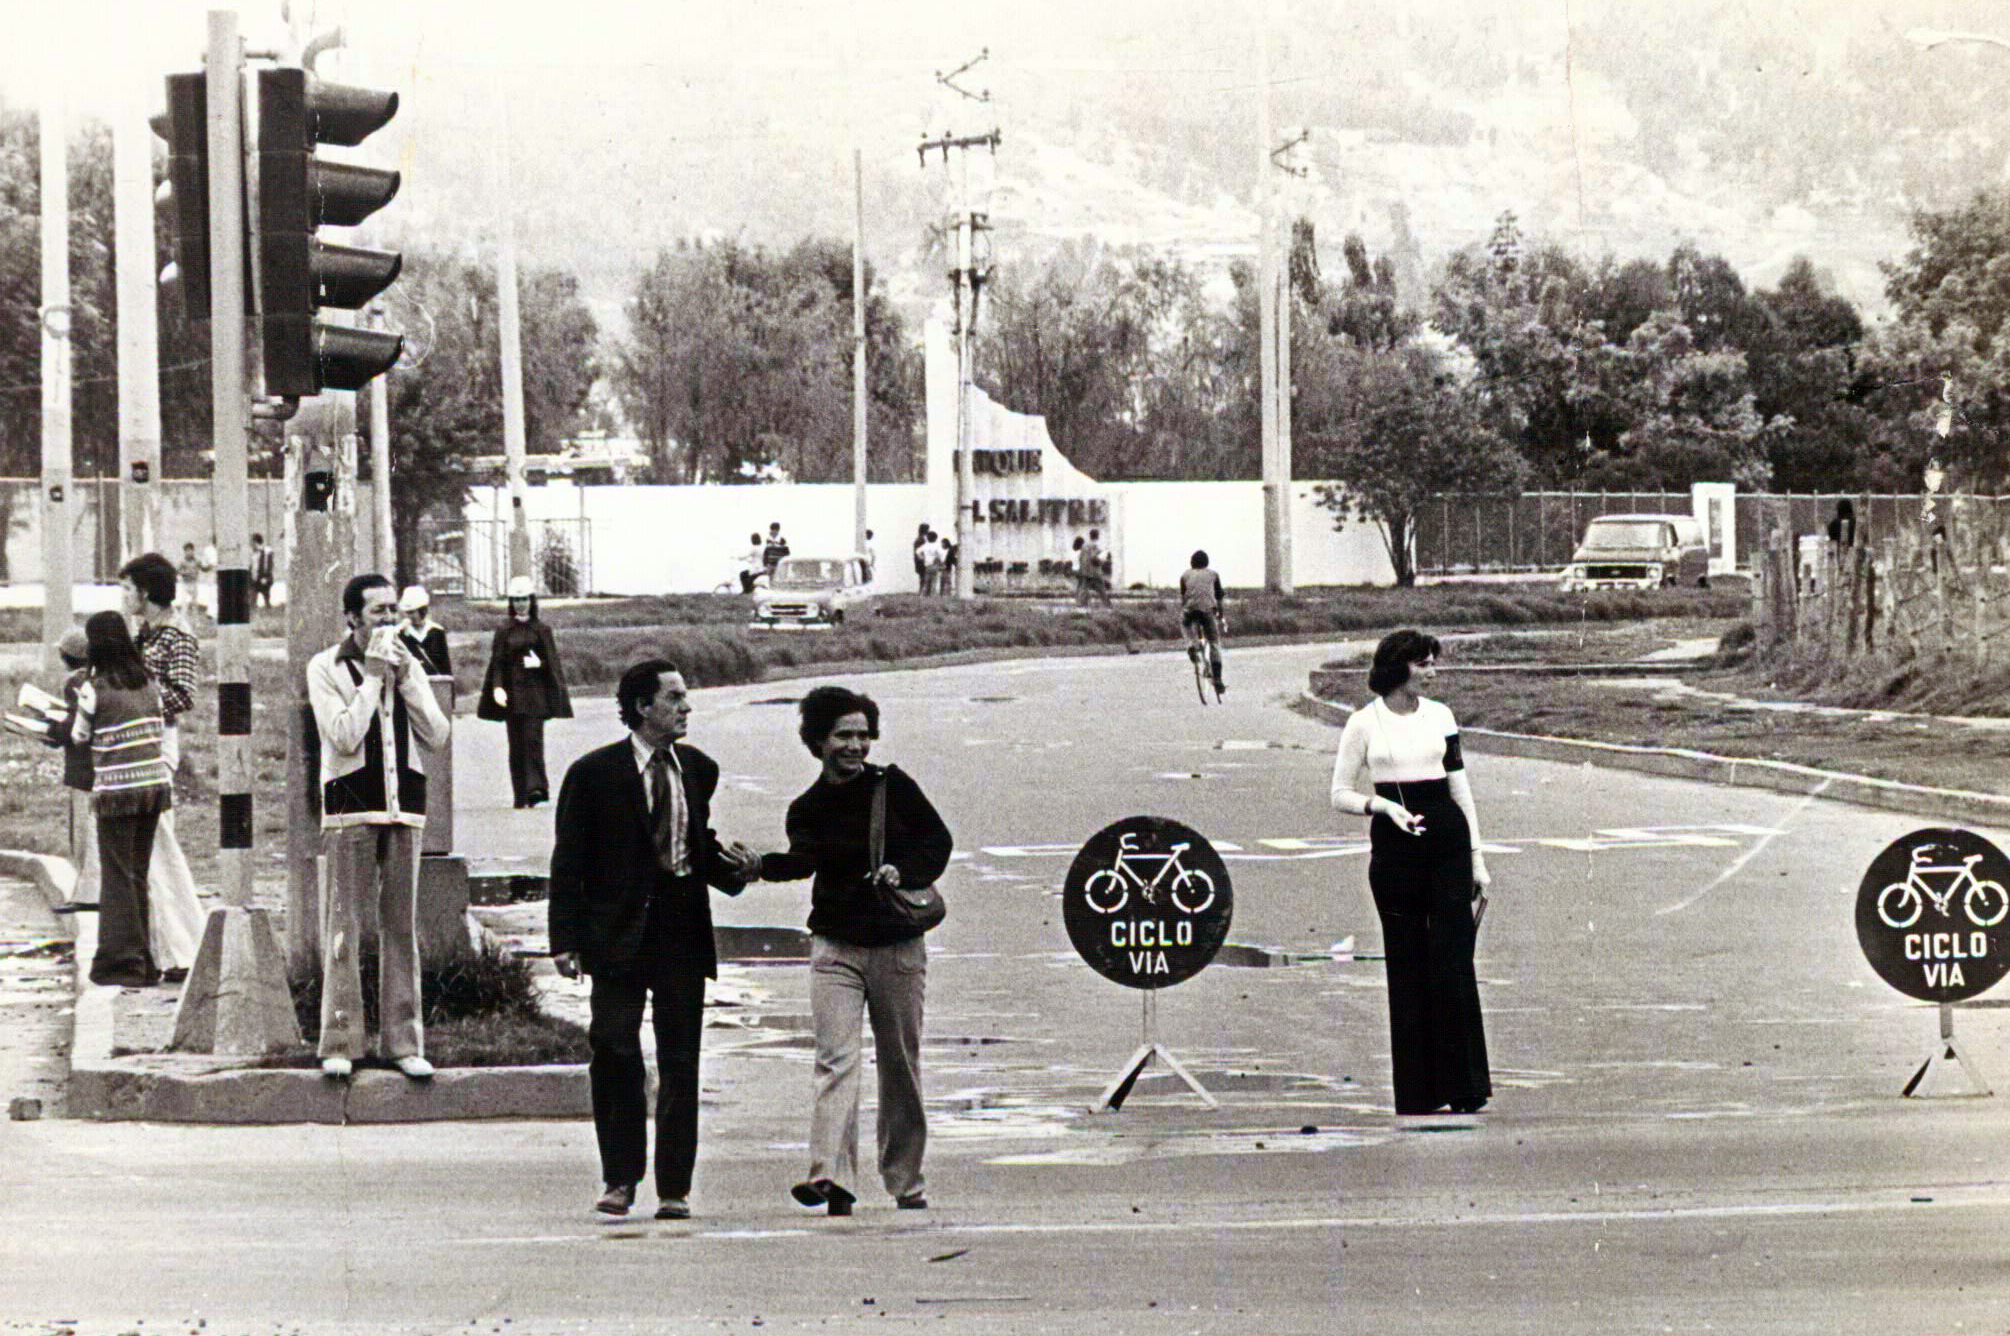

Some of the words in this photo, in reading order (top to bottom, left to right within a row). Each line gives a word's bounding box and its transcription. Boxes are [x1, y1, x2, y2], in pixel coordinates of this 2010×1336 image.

[1111, 920, 1193, 947] CICLO
[1904, 931, 1988, 960] CICLO
[1129, 951, 1170, 974] VIA
[1923, 962, 1966, 988] VIA
